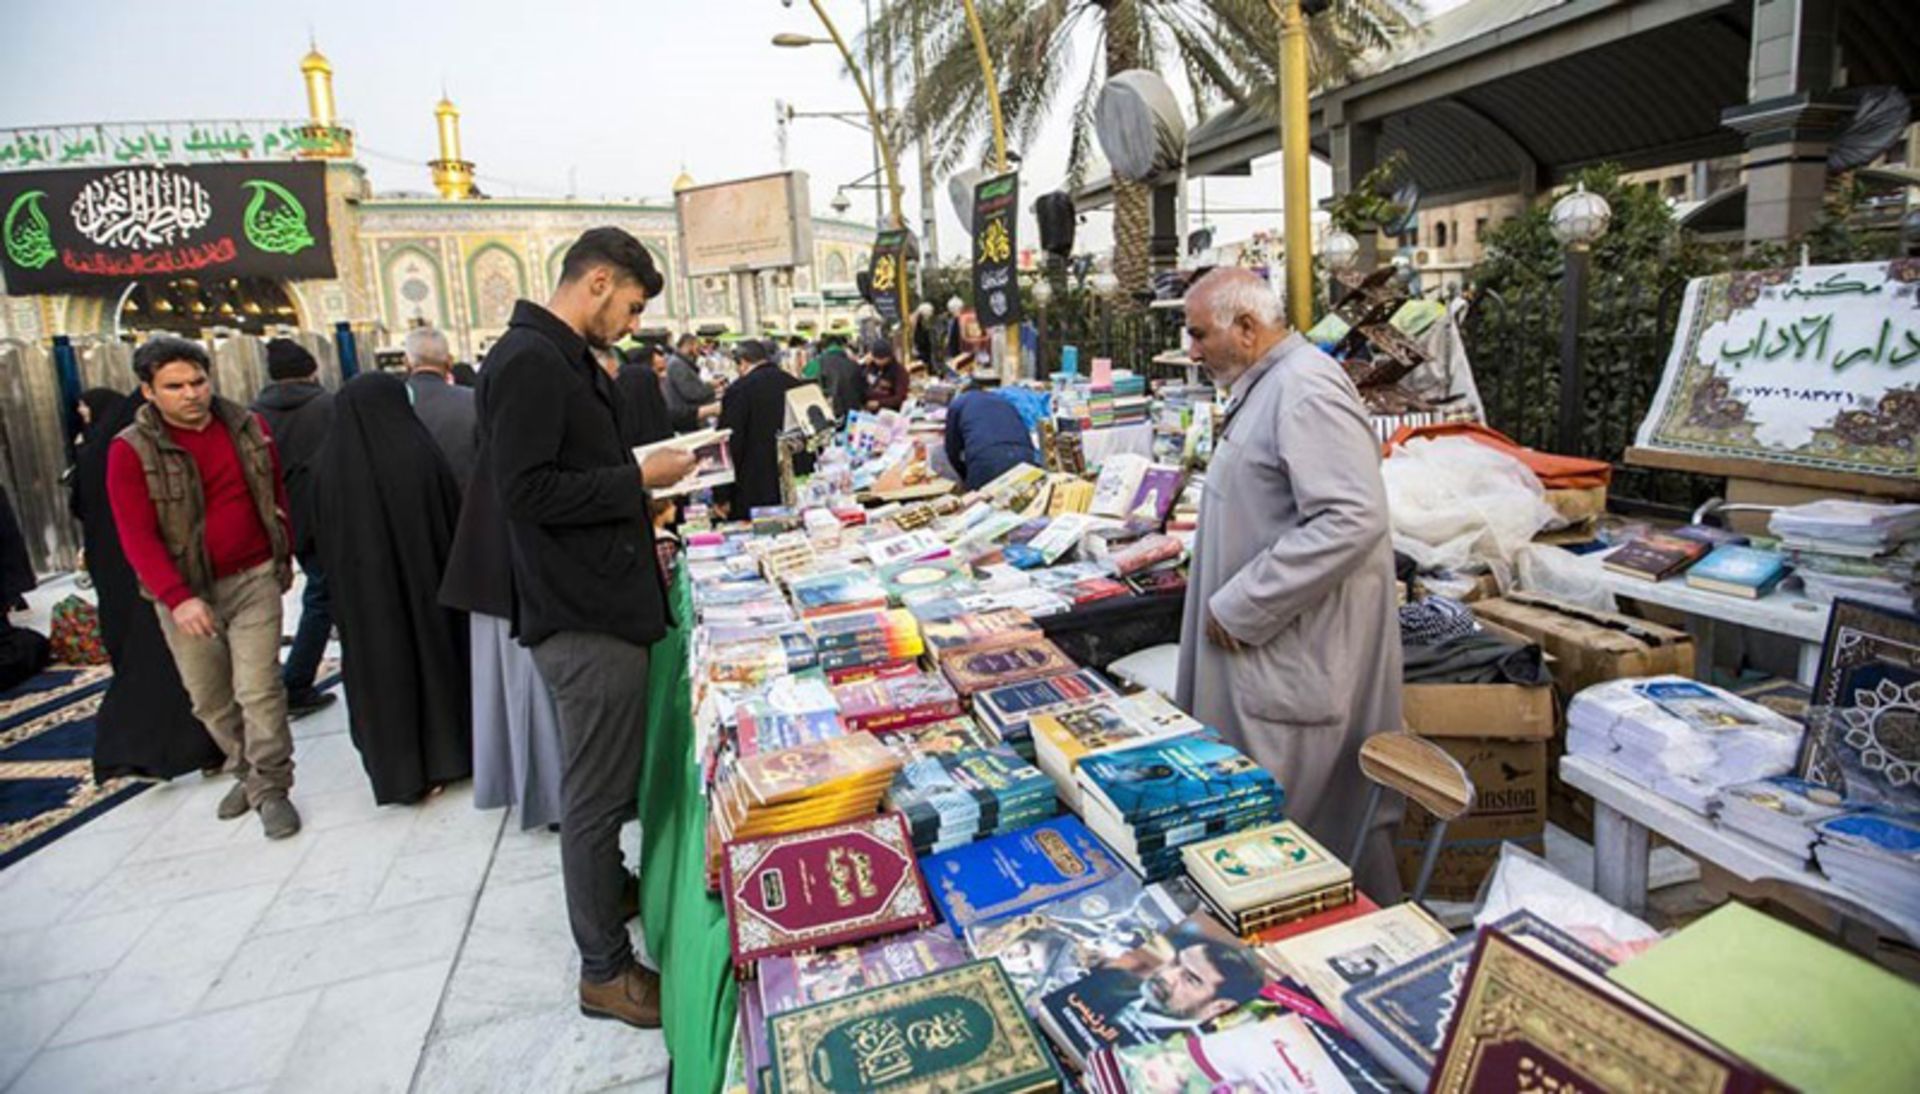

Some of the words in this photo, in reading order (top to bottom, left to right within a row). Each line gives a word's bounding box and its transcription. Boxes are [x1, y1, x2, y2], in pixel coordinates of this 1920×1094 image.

[184, 127, 254, 158] عليك
[1781, 272, 1882, 300] مكتبة
[1833, 317, 1920, 370] دار
[1478, 787, 1537, 809] inston
